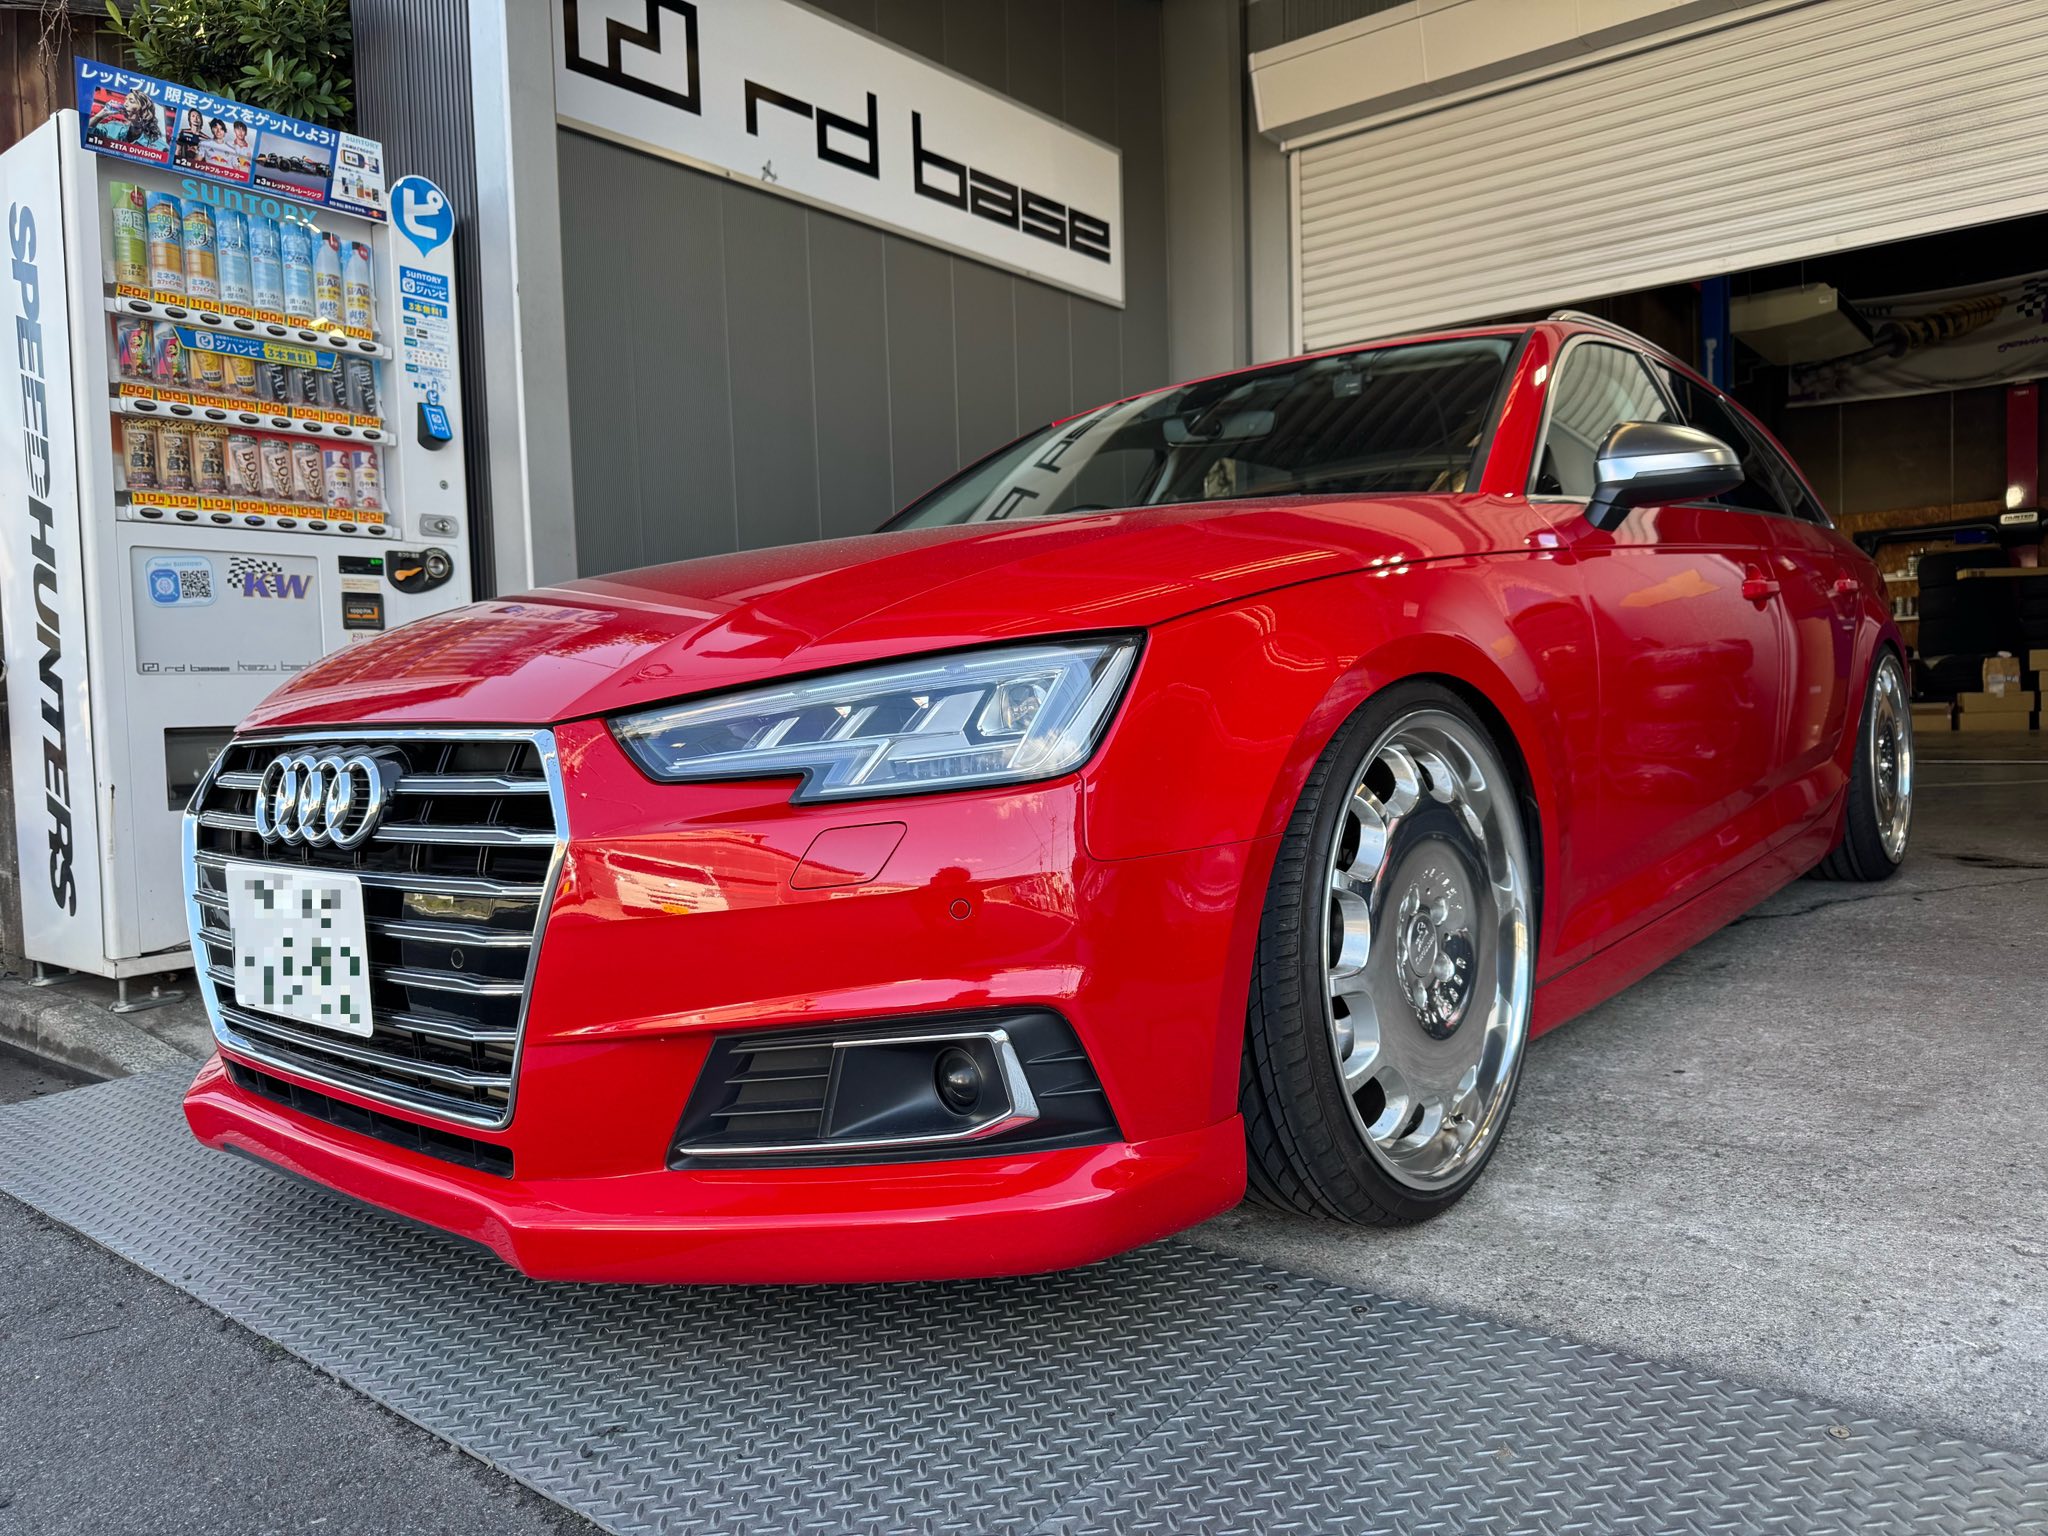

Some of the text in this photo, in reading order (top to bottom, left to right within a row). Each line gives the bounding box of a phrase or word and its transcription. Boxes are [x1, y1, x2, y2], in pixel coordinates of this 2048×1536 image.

[81, 63, 336, 148] レッドブル 限定グッズをゲットしよう!
[110, 141, 127, 152] ZETA
[129, 147, 162, 160] DIVISION
[744, 78, 1111, 264] rd base
[405, 270, 442, 284] SUNTORY
[215, 340, 259, 357] ジハンピ
[242, 451, 260, 492] BOSS
[275, 456, 291, 499] BOSS
[306, 458, 323, 499] BOSS
[243, 571, 313, 599] KW
[165, 664, 230, 672] rd base
